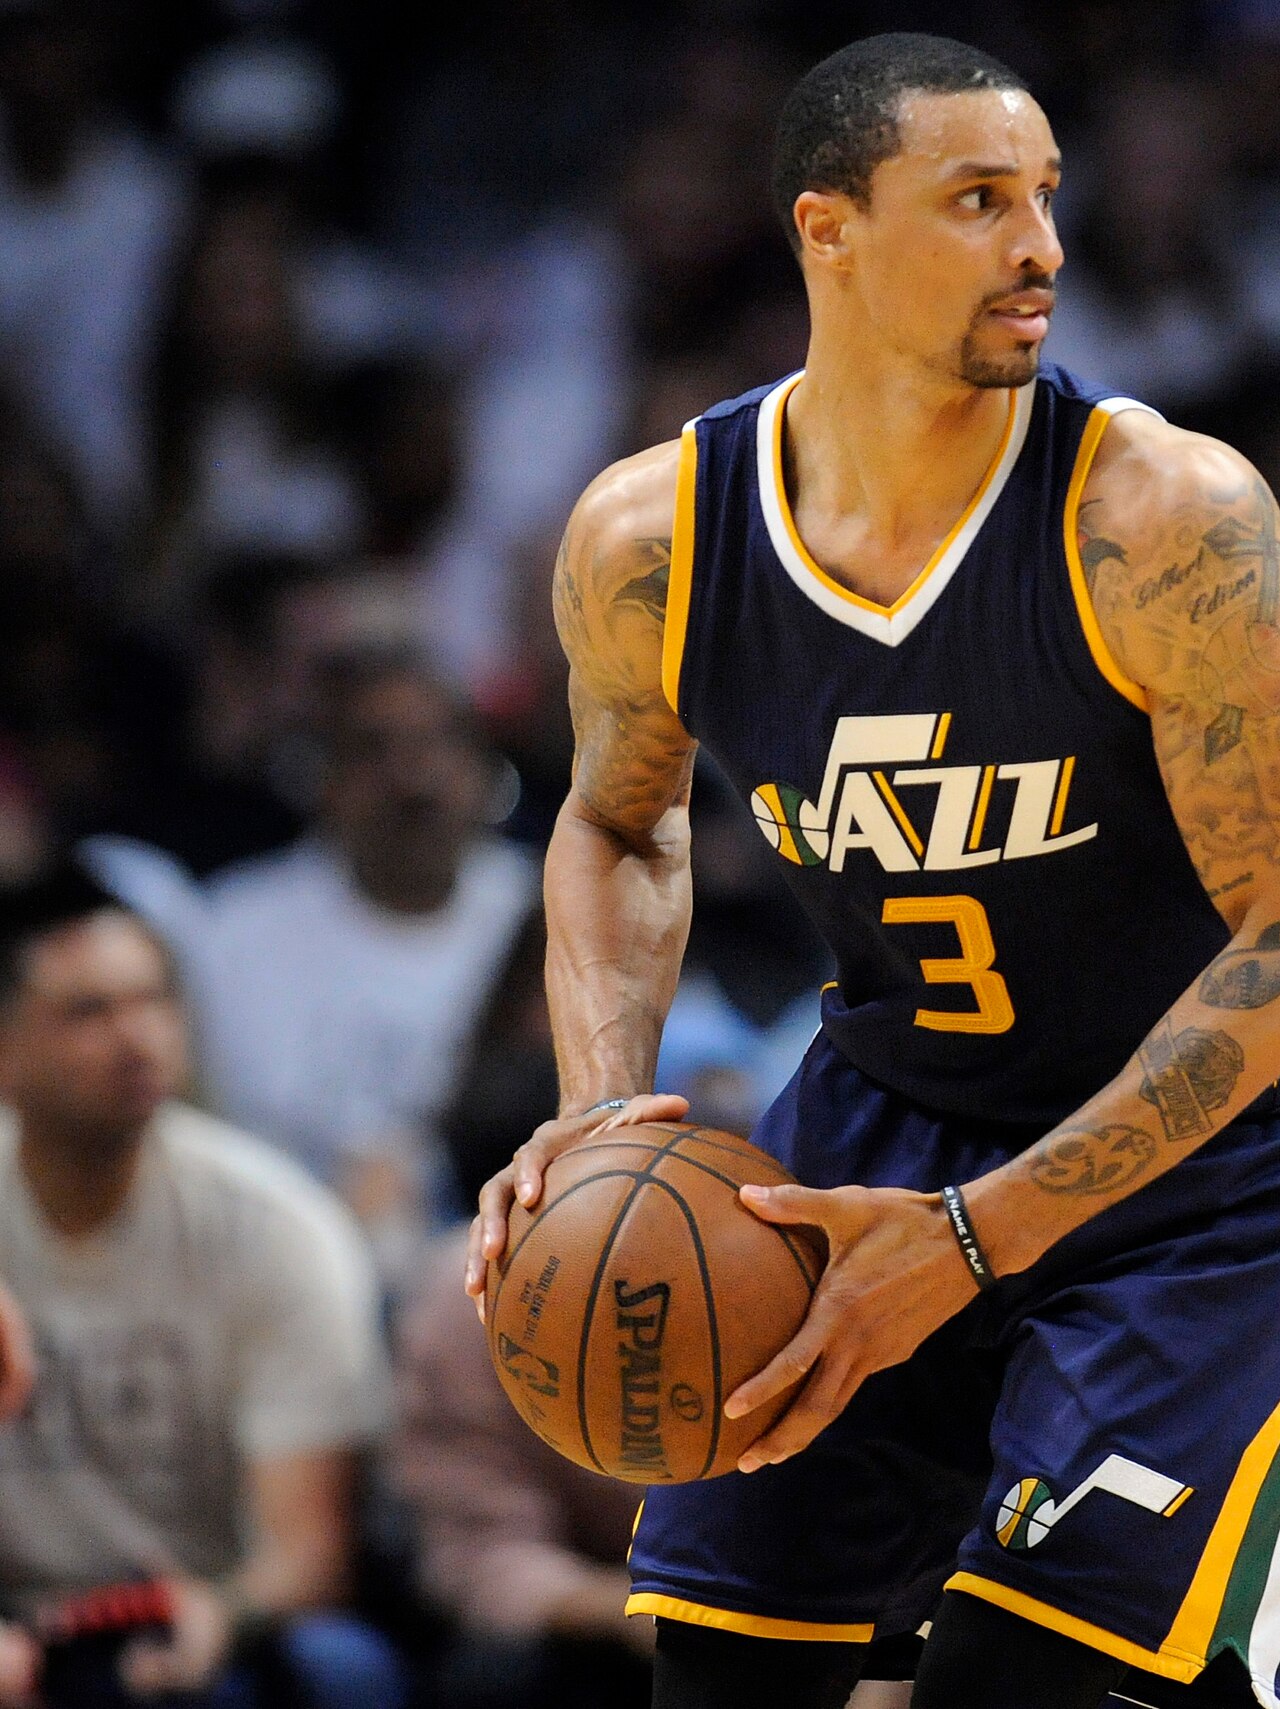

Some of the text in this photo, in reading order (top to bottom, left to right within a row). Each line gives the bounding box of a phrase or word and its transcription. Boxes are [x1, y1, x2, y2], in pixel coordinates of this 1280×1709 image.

[751, 713, 1099, 873] JAZZ
[881, 895, 1015, 1034] 3
[948, 1199, 968, 1236] NAME
[966, 1247, 985, 1274] PLAY
